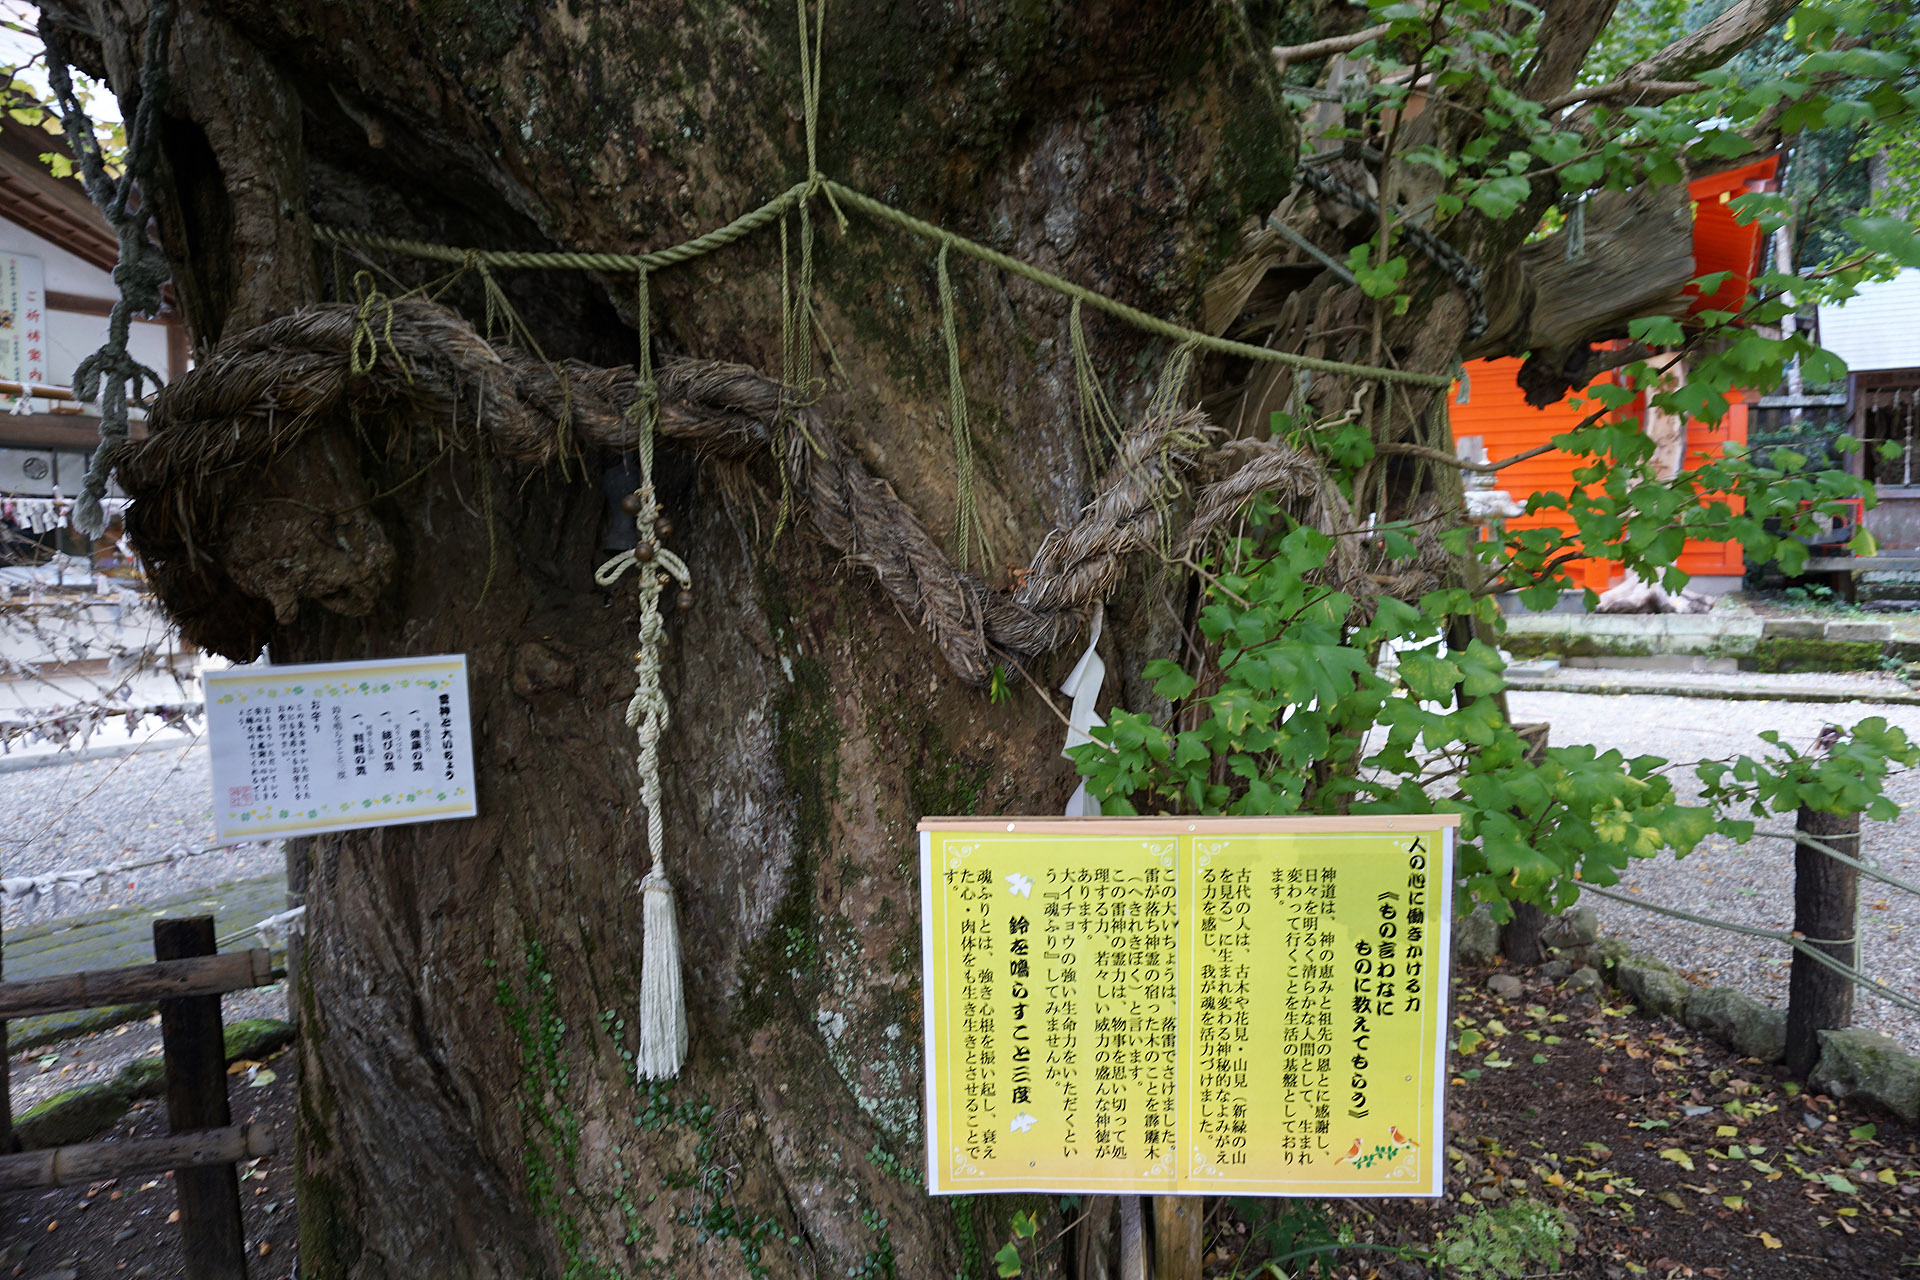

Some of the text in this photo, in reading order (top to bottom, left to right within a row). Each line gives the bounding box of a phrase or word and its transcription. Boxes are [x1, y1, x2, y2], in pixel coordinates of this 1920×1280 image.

[310, 700, 322, 734] お守り
[944, 869, 960, 893] す。
[977, 868, 997, 1160] 魂ふりとは、強き心根を振い起し、衰え
[1008, 915, 1032, 1105] 鈴を鳴らすこと三度
[1043, 868, 1061, 1087] う『魂ふり』してみませんか。
[1060, 868, 1078, 1158] 大イチョウの強い生命力をいただくとい
[1077, 868, 1093, 941] あります。
[1094, 868, 1111, 1159] 理する力、若々しい威力の盛んな神徳が
[1110, 868, 1127, 1160] この雷神の霊力は、物事を思い切って処
[1160, 869, 1178, 1151] この大いちょうは、落雷でさけました。
[1199, 868, 1217, 1140] る力を感じ、我が魂を活力づけました。
[1271, 868, 1287, 906] ます。
[1282, 868, 1302, 1166] 変わって行くことを生活の基盤としており
[1297, 868, 1319, 1165] 日々を明るく清らかな人間として、生まれ
[1314, 867, 1336, 1157] 神道は、神の恵みと祖先の恩とに感謝し、
[1404, 837, 1427, 1012] 人の心に働きかける力
[1347, 939, 1373, 1119] ものに教えてもらう》
